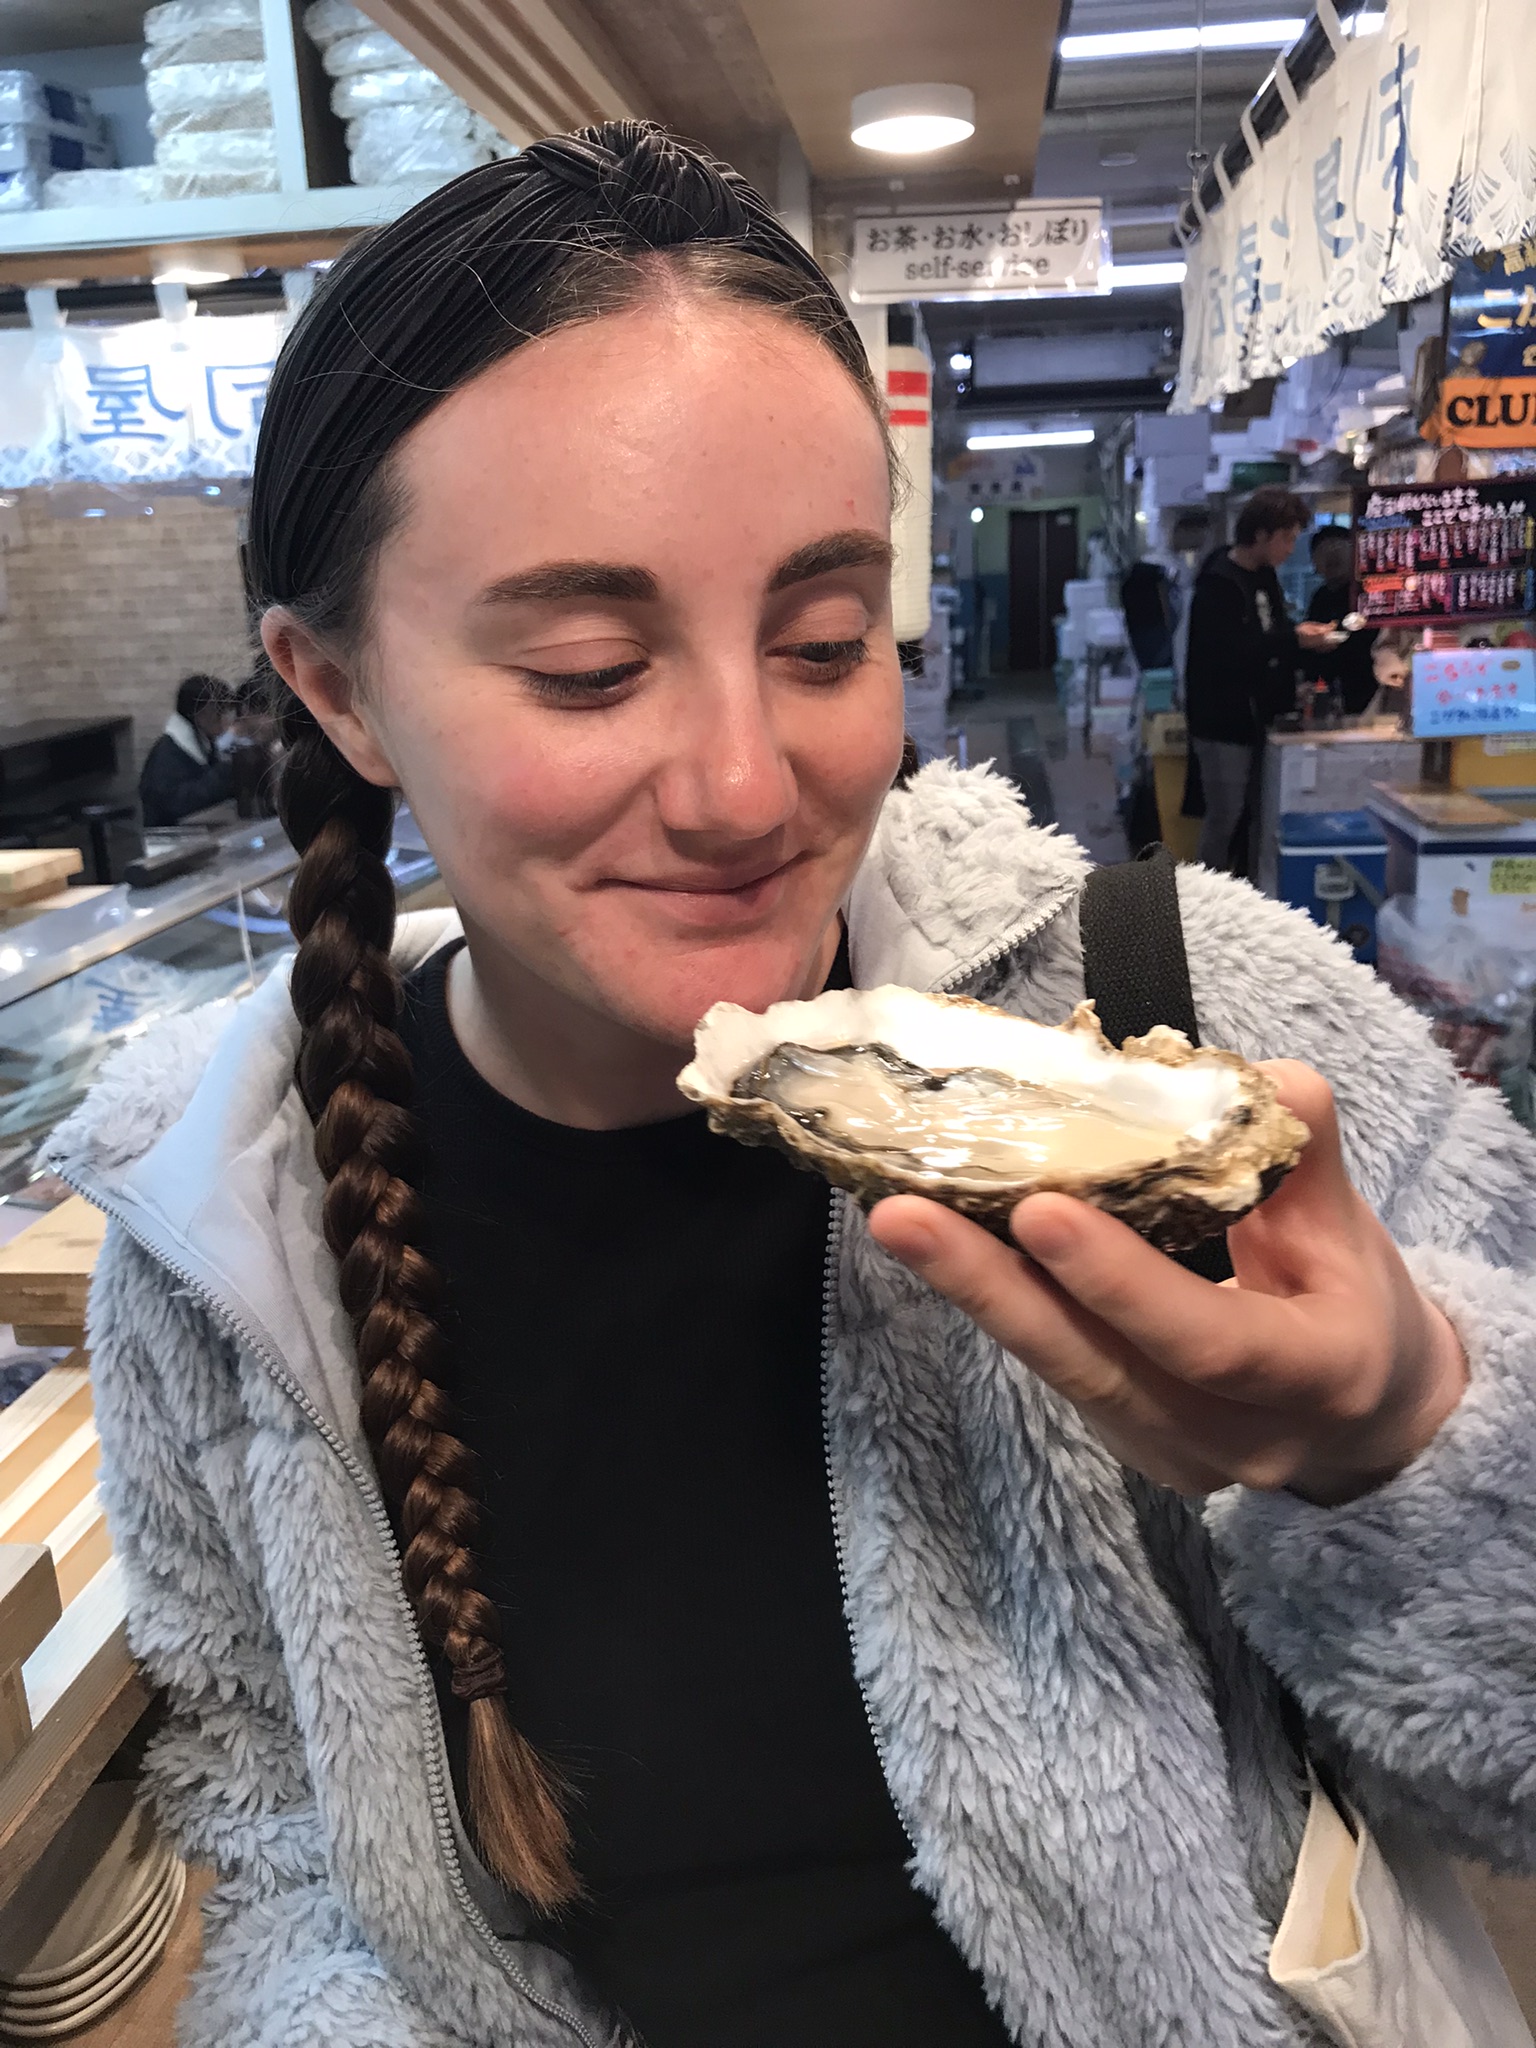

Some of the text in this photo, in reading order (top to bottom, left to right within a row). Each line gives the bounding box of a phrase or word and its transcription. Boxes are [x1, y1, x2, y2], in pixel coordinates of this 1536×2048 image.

[867, 217, 1089, 252] お茶・お水・おしぼり
[1447, 393, 1536, 427] CLU
